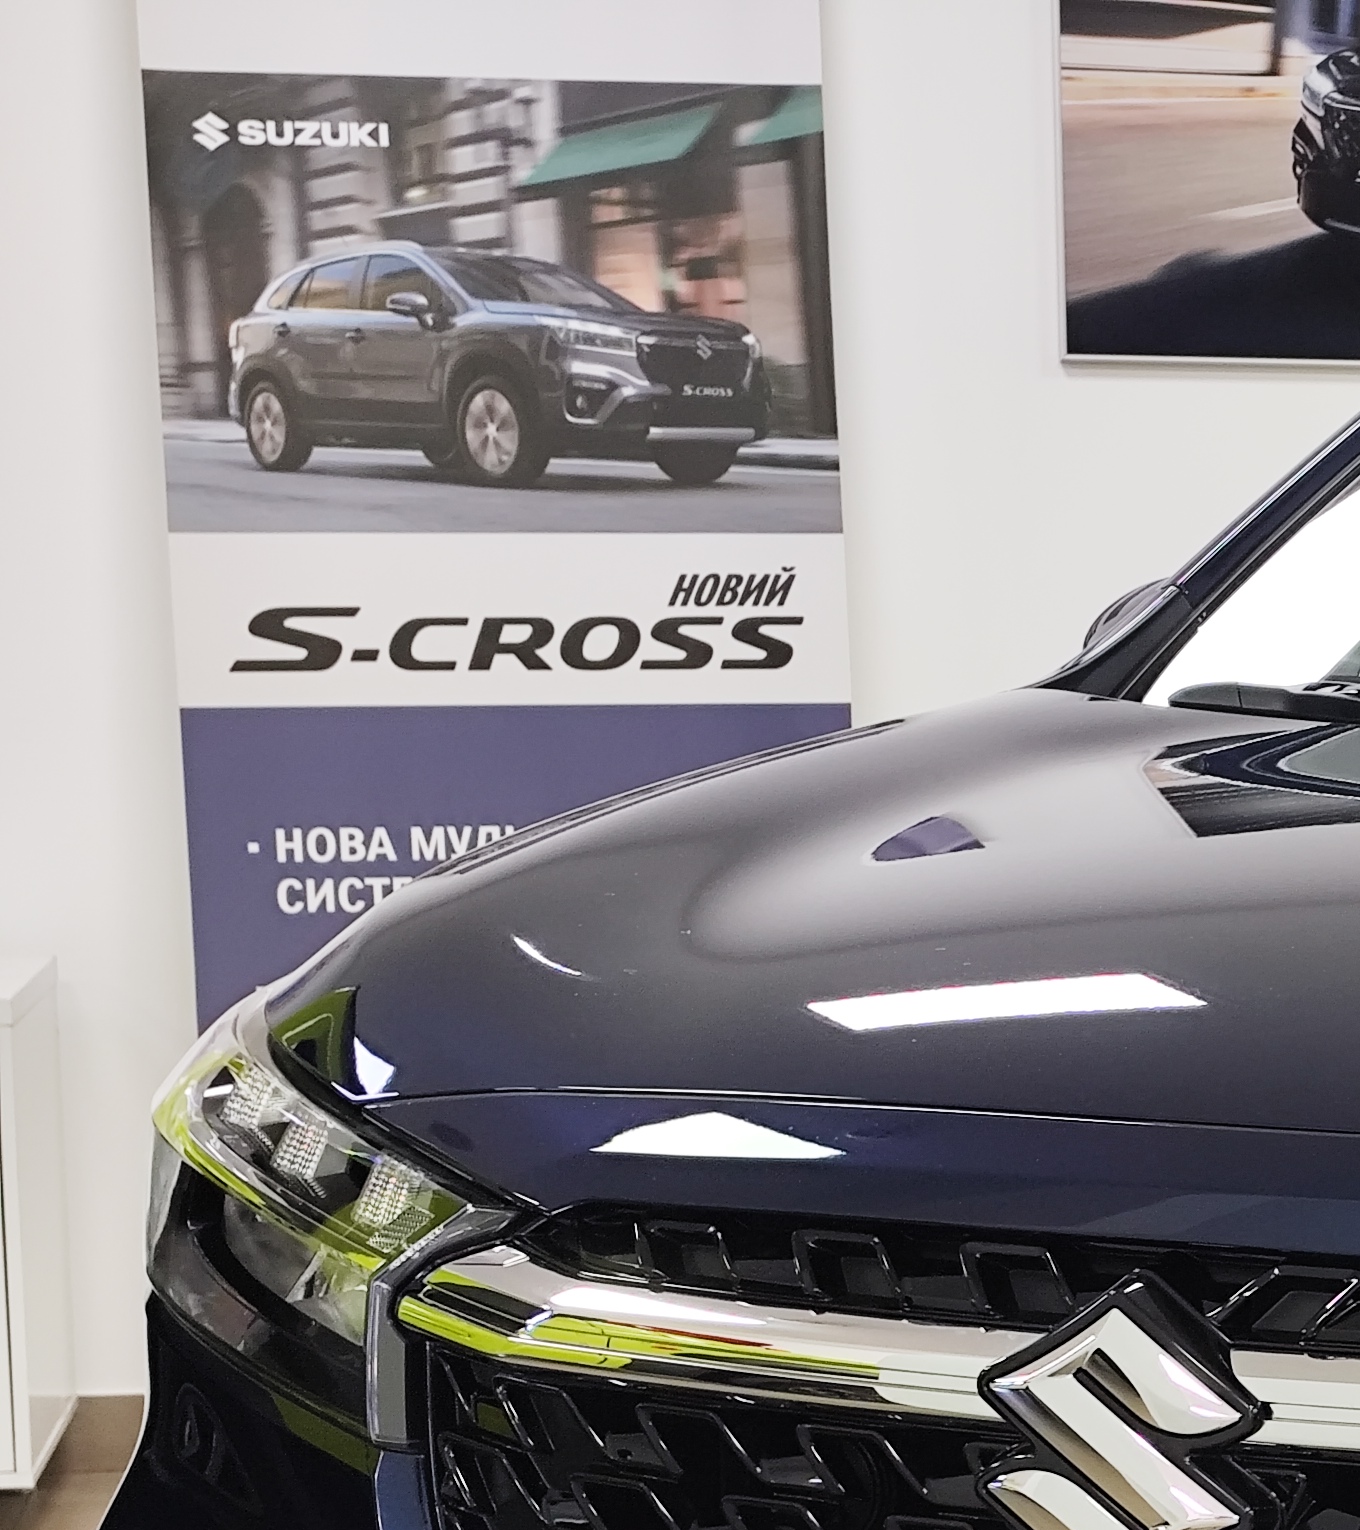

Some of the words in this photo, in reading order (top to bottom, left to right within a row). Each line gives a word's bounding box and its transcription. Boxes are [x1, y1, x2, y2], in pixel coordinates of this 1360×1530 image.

[237, 119, 390, 148] SUZUKI
[668, 566, 797, 608] НОВИЙ
[229, 606, 804, 673] S-CROSS
[275, 826, 398, 863] НОВА
[276, 876, 414, 915] СИСТ
